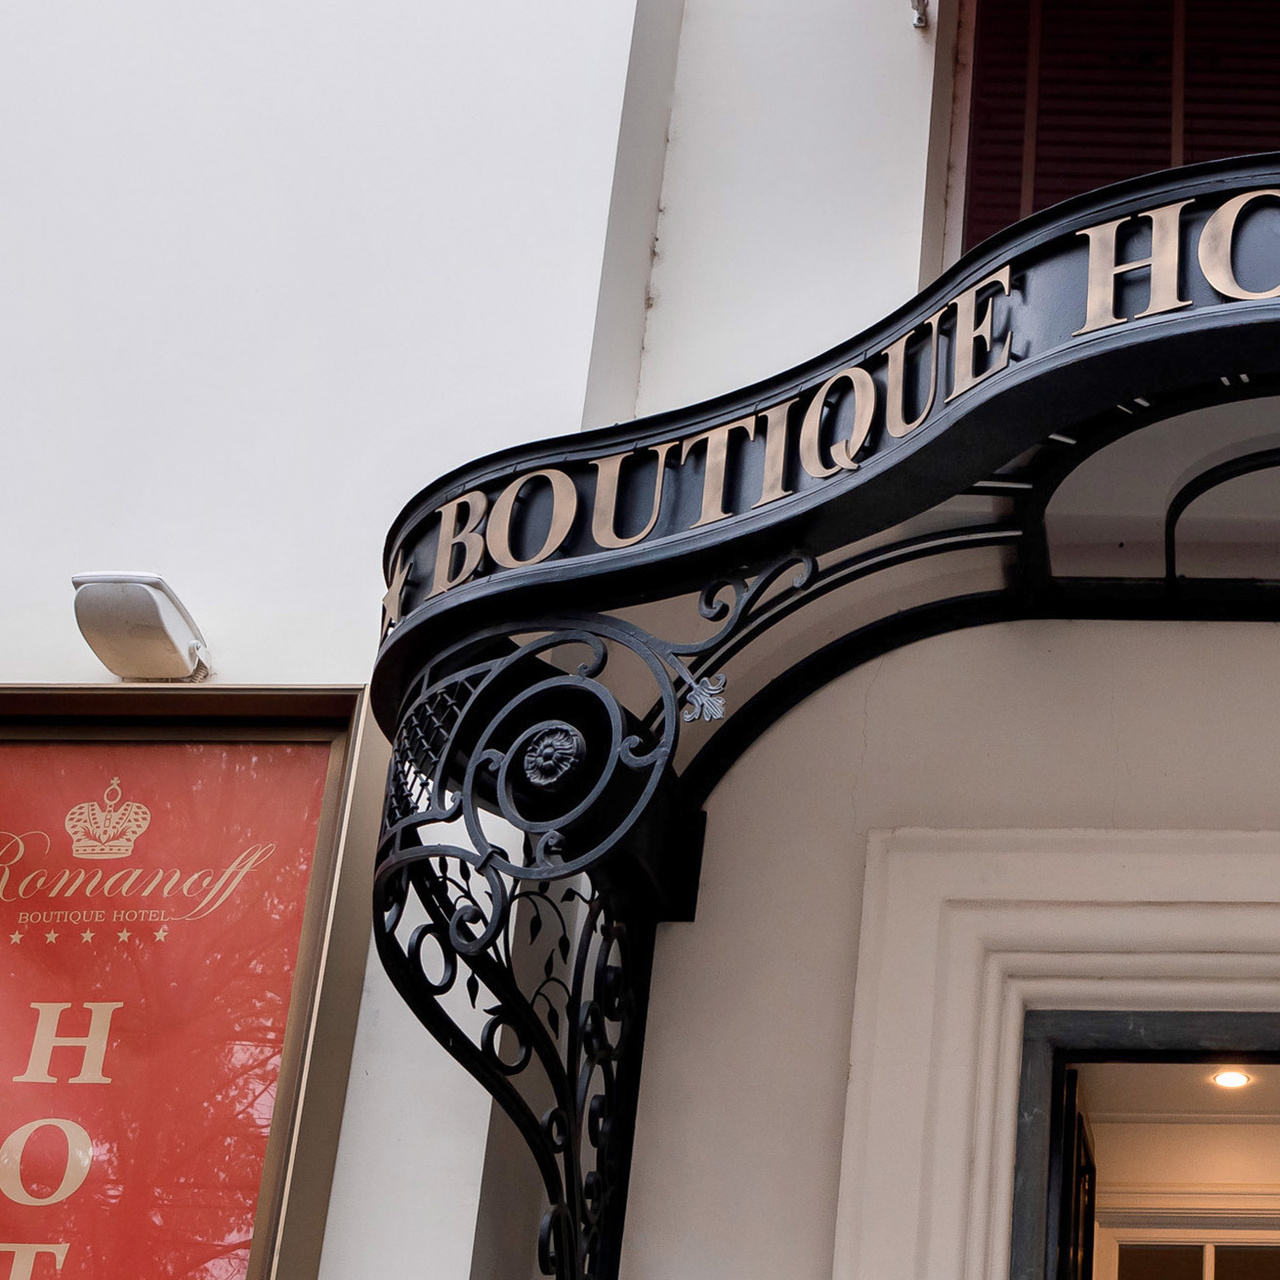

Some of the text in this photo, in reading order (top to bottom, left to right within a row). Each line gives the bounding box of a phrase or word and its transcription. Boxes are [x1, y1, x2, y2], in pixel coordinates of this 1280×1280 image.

[424, 265, 1013, 600] BOUTIQUE
[18, 909, 173, 925] BOUTIQUE HOTEL
